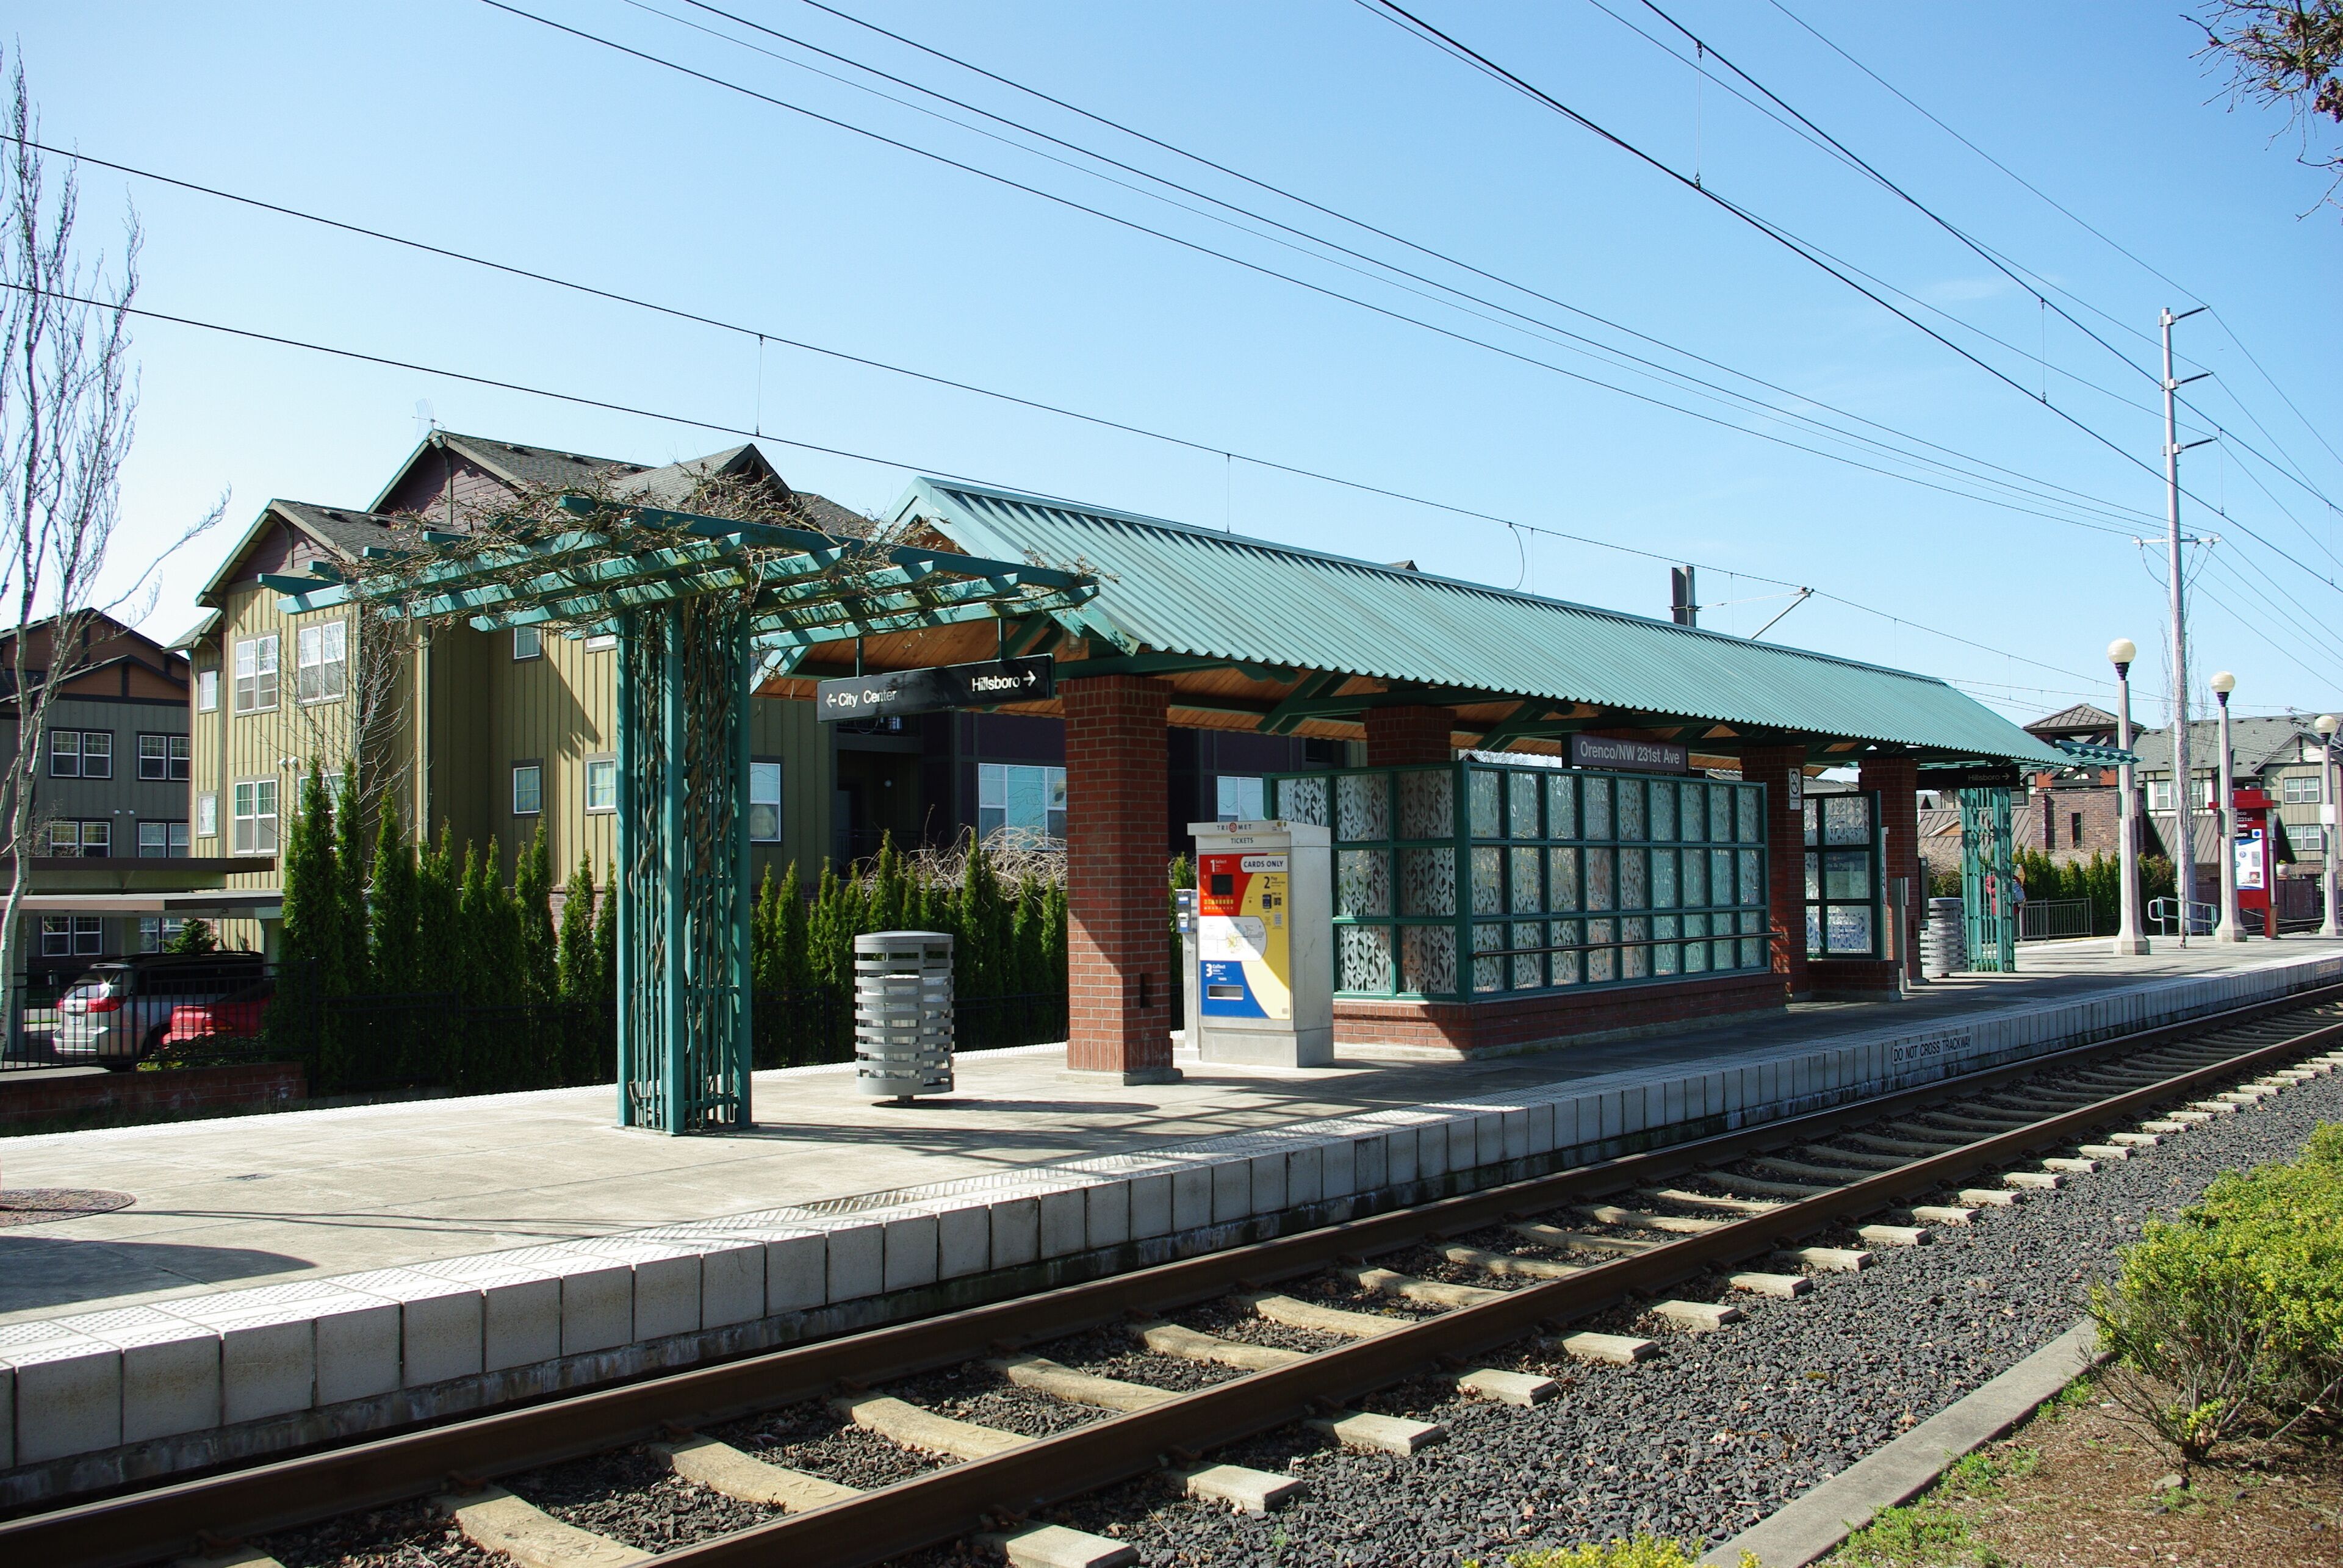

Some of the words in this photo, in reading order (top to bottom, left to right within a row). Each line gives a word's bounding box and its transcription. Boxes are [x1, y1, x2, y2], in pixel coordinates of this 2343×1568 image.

[972, 675, 1020, 692] Hillsboro
[838, 692, 858, 707] City
[863, 689, 897, 703] Center
[1580, 741, 1635, 761] Orenco/NW
[1637, 746, 1661, 763] 231st
[1663, 749, 1680, 764] Ave
[1210, 859, 1215, 872] 1
[1264, 876, 1270, 889] 2
[1206, 963, 1212, 977] 3
[1894, 1048, 1903, 1062] DO
[1906, 1045, 1918, 1059] NOT
[1920, 1041, 1940, 1056] CROSS
[1942, 1035, 1971, 1051] TRACKWAY
